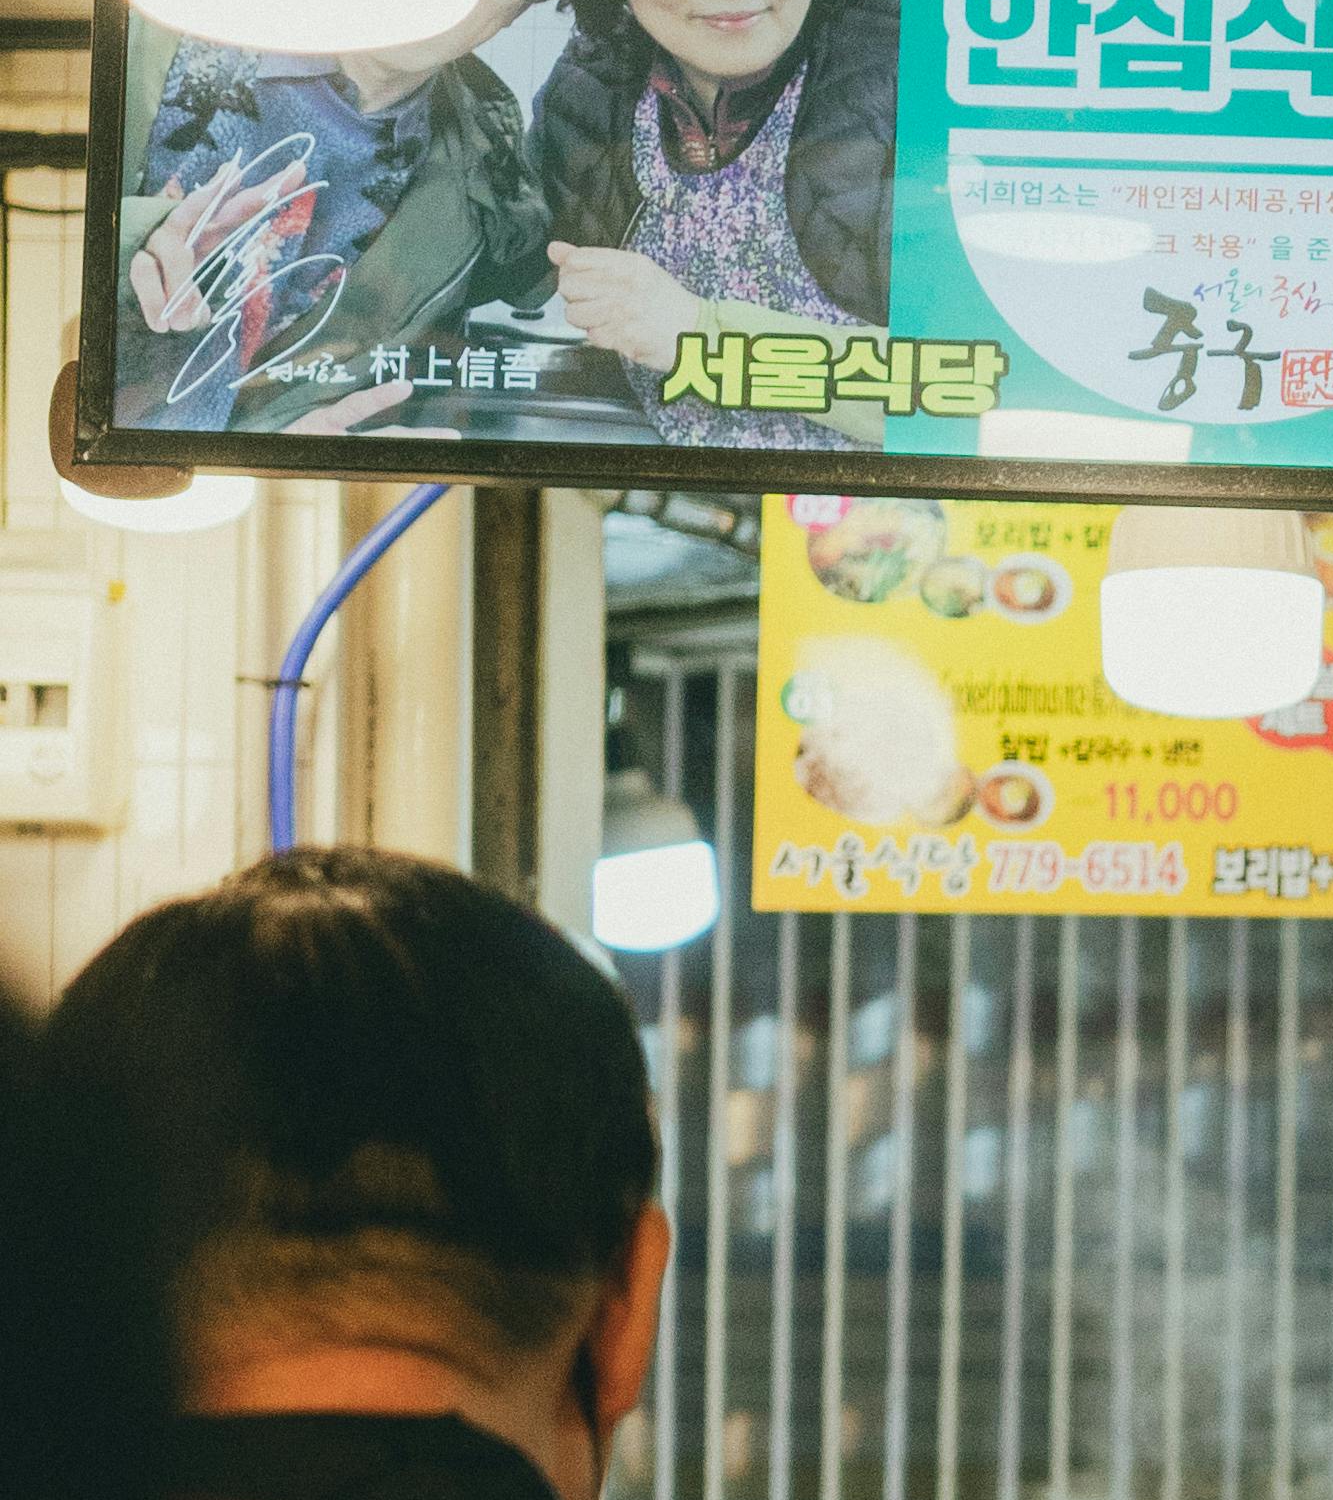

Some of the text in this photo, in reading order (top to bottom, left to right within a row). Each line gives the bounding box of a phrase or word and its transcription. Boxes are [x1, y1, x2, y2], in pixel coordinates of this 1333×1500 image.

[963, 179, 1100, 205] 저희업소는
[1269, 235, 1296, 261] 을
[663, 333, 1005, 414] 서울식당
[1105, 781, 1239, 823] 11,000
[990, 843, 1187, 889] 779-6514
